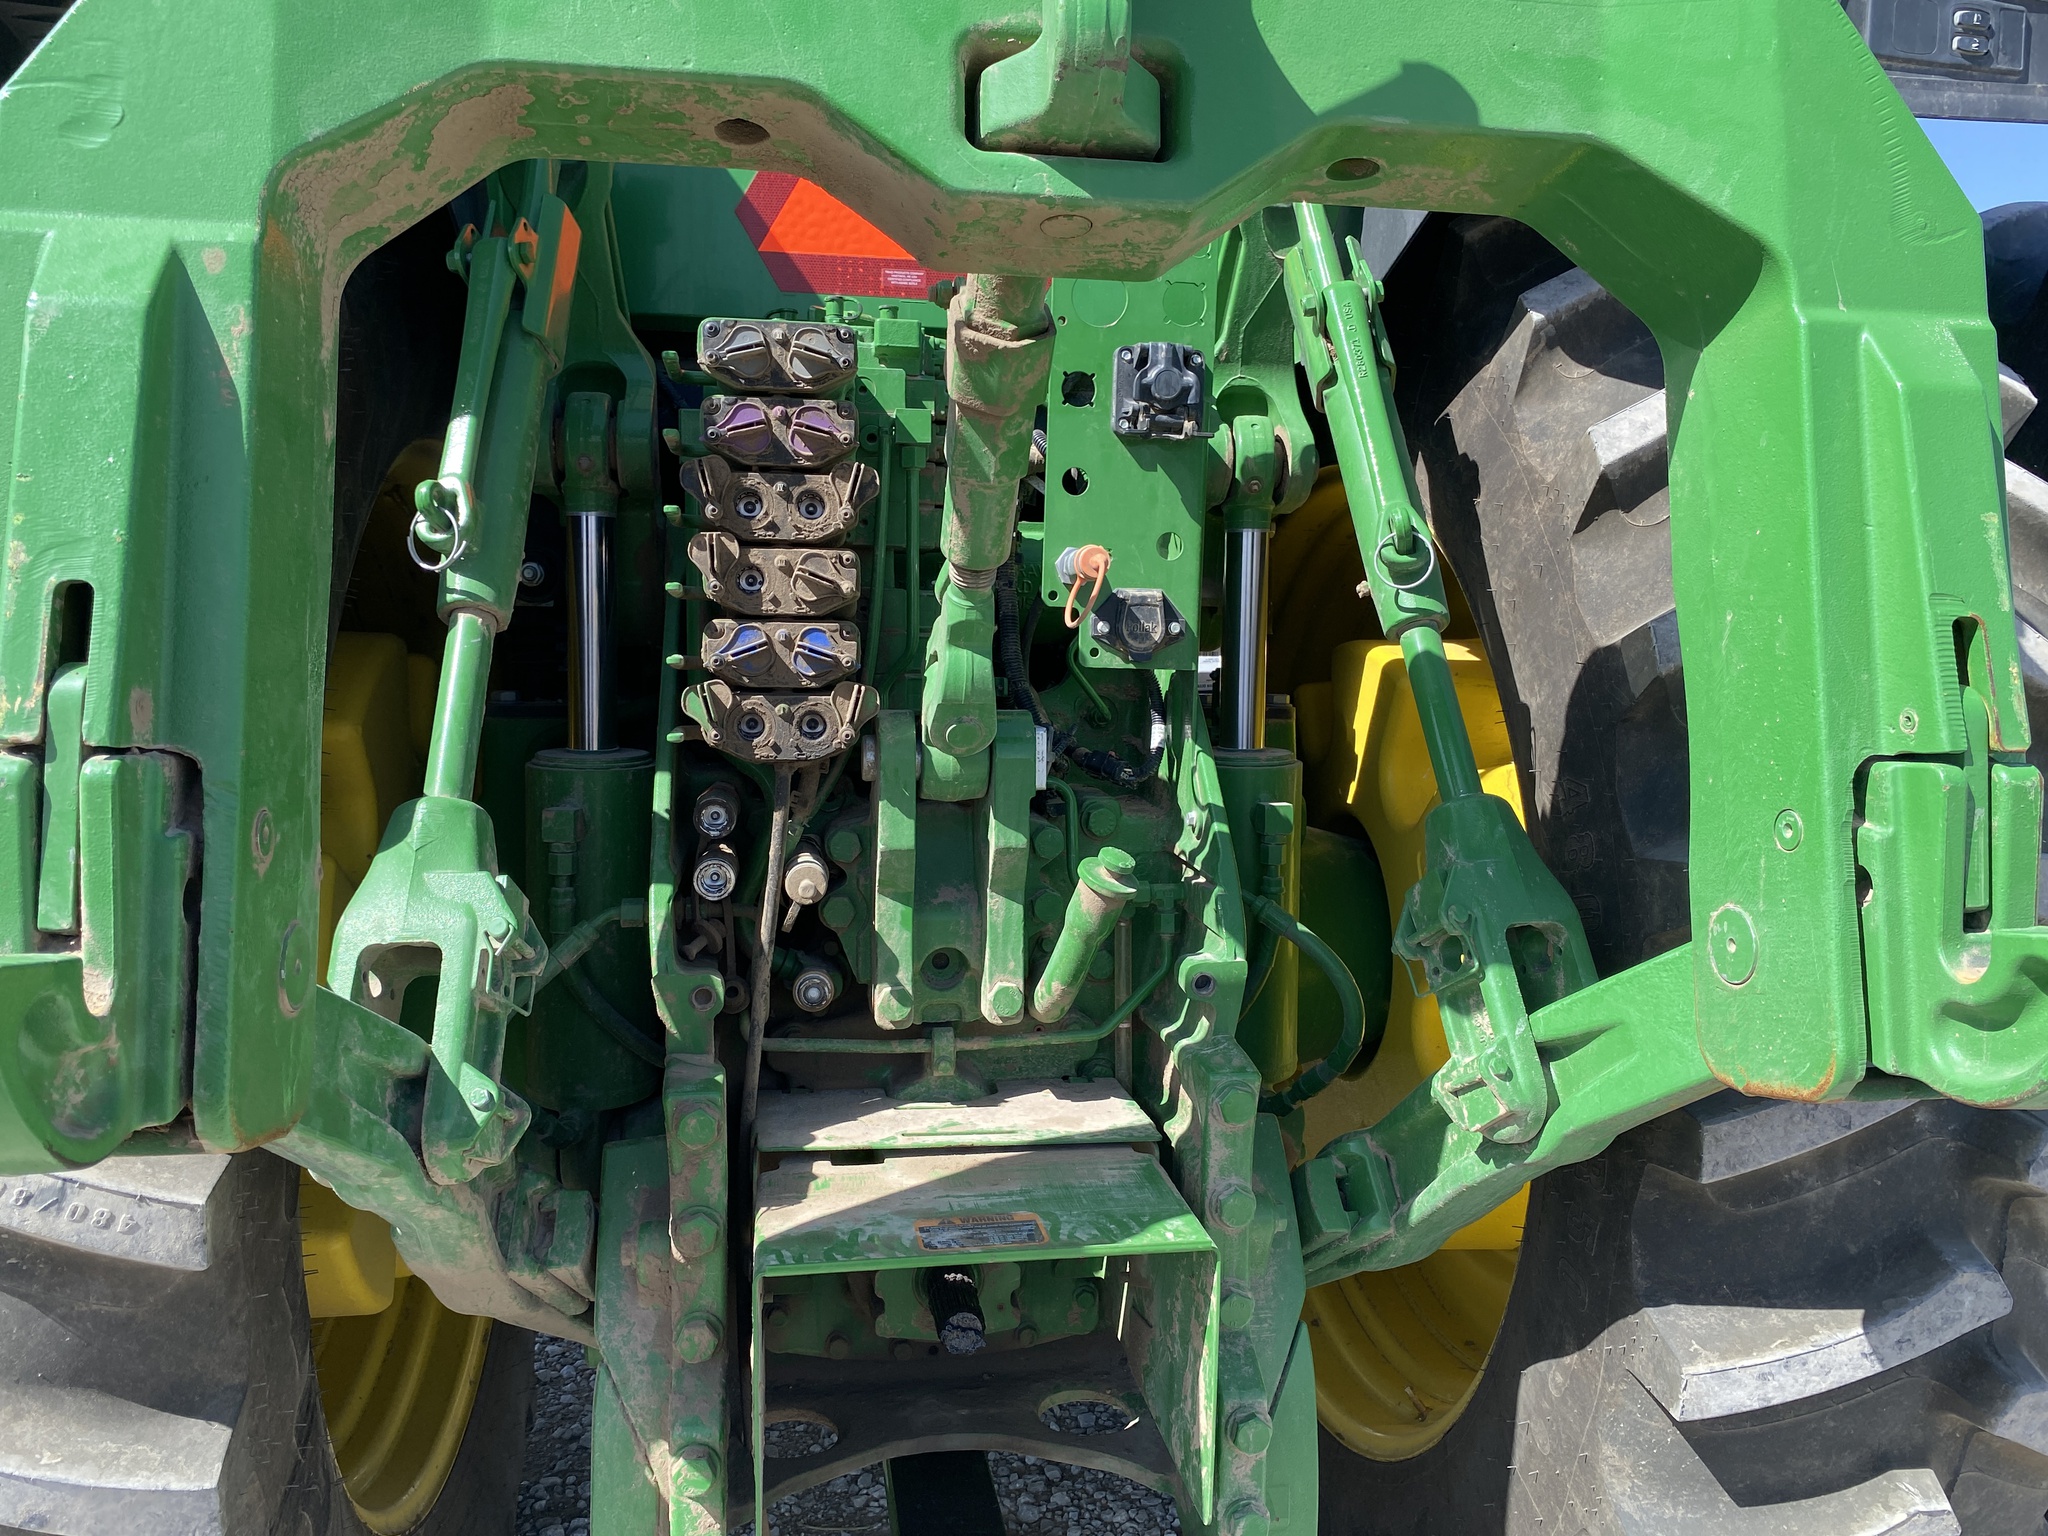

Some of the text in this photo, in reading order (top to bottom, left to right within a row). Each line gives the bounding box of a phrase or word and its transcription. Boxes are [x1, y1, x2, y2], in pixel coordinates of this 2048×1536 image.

[1342, 301, 1354, 320] USA
[0, 1182, 142, 1235] 480/8
[960, 1214, 1015, 1225] WARNING
